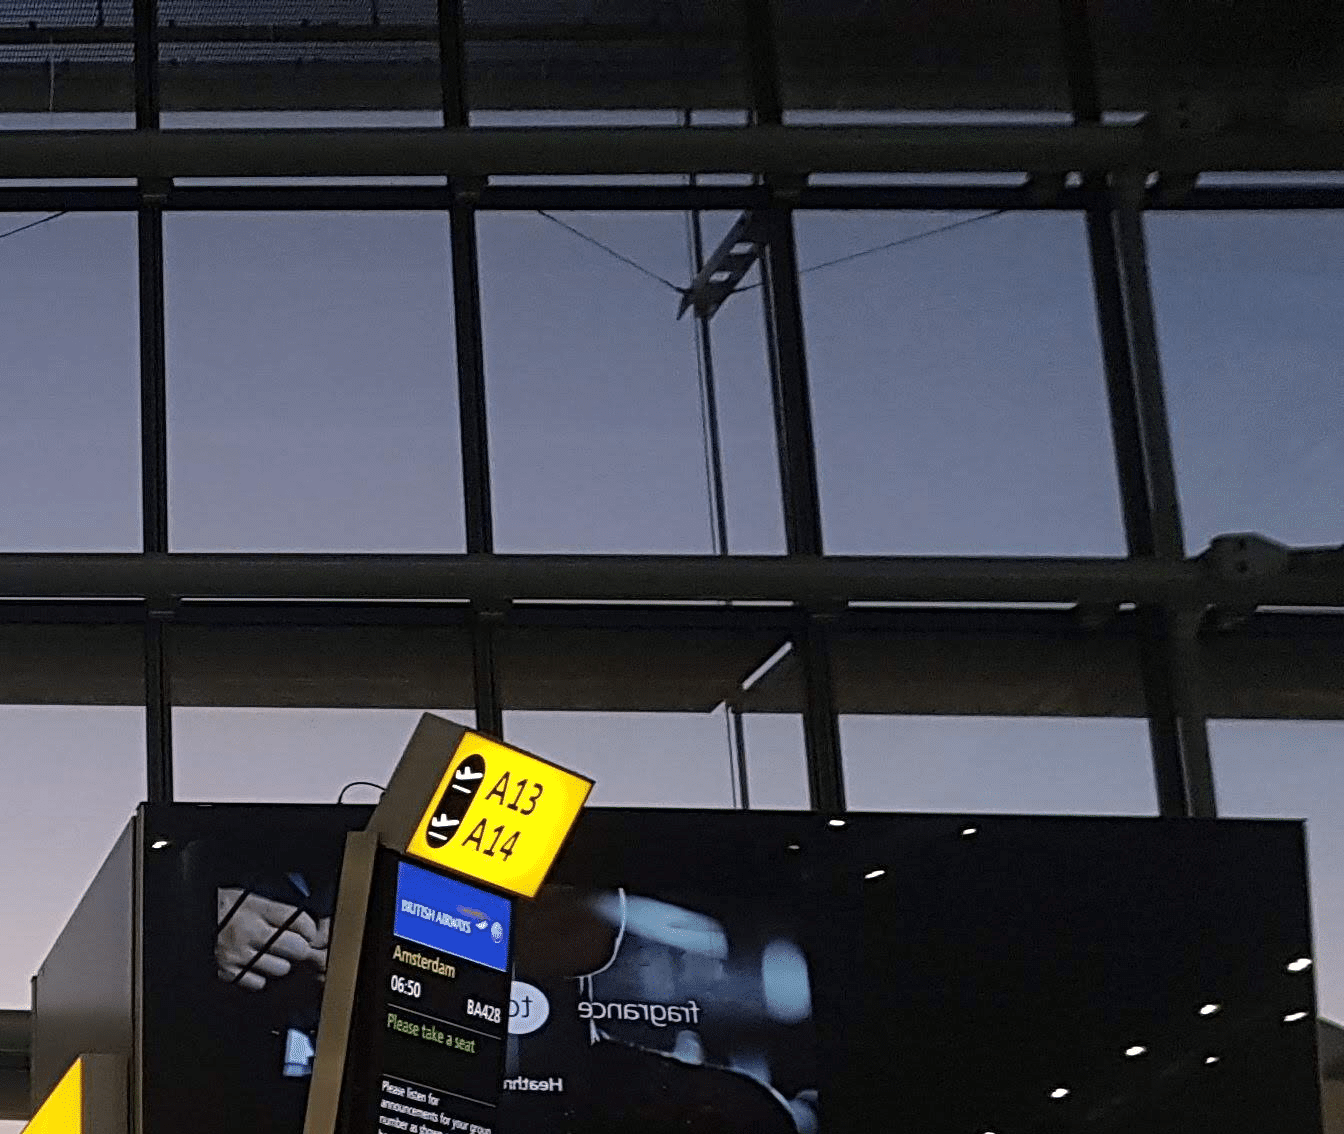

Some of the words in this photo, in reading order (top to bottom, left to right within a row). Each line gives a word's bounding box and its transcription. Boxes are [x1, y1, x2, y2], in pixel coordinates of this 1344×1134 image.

[484, 771, 544, 816] A13
[461, 818, 522, 862] A14
[401, 899, 436, 921] BRITISH
[435, 911, 472, 934] AIRWAYS
[392, 944, 456, 979] Amsterdam
[390, 974, 422, 998] 06:50
[466, 998, 502, 1024] BA428
[387, 1012, 420, 1037] Please
[421, 1024, 444, 1044] take
[445, 1034, 453, 1047] a
[454, 1036, 476, 1054] seat
[381, 1080, 406, 1097] Please
[406, 1087, 427, 1103] listen
[428, 1092, 440, 1106] for
[379, 1115, 408, 1131] number
[409, 1123, 418, 1134] as
[380, 1099, 439, 1123] announcements
[440, 1112, 451, 1126] for
[451, 1118, 470, 1131] your
